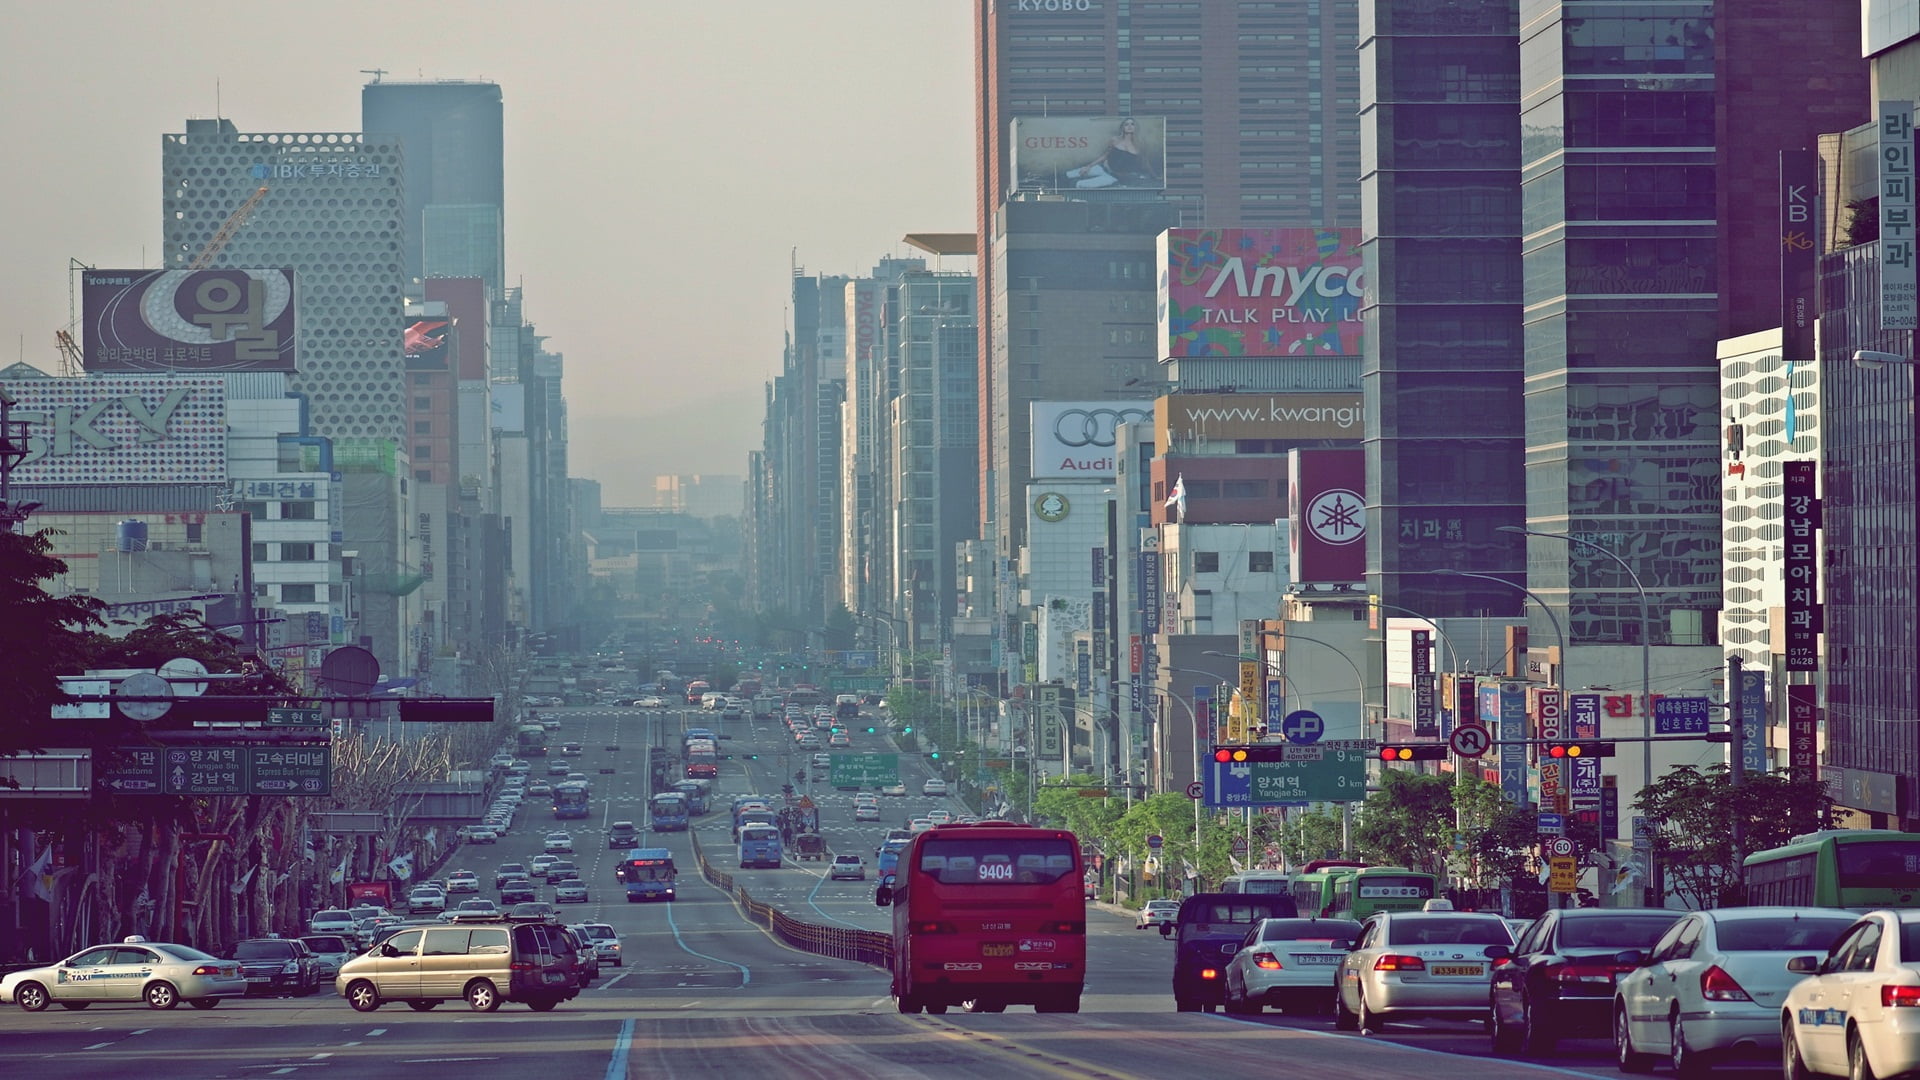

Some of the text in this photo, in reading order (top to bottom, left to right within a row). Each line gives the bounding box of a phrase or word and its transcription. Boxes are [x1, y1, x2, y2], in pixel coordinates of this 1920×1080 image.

[1018, 0, 1090, 11] KYOBO
[1025, 136, 1089, 149] GUESS
[273, 163, 380, 178] IBK 투자증권
[1885, 113, 1912, 268] 라인피부과
[1789, 186, 1807, 222] KB
[1202, 308, 1259, 323] TALK
[1272, 308, 1330, 323] PLAY
[857, 290, 875, 361] PAGODA
[97, 347, 214, 363] 헬리코박터 프로젝트
[1060, 457, 1113, 470] Audi
[1401, 518, 1441, 540] 치과
[1790, 495, 1813, 629] 강남모아치과
[1790, 648, 1812, 656] 517-
[1790, 657, 1814, 666] 0428
[1269, 683, 1280, 719] 세무사
[1656, 701, 1708, 714] 예측출발금지
[1326, 739, 1376, 749] 직진 후 좌회전
[171, 752, 186, 761] 92
[190, 750, 236, 762] 양재역
[255, 752, 324, 766] 고속터미널
[1336, 750, 1362, 762] 9 km
[192, 763, 225, 771] Yangjae
[257, 767, 320, 776] Express Bus Terminal
[1258, 761, 1290, 769] Naegok
[191, 772, 235, 785] 강남역
[306, 780, 318, 788] 31
[1258, 775, 1299, 788] 양재역
[1337, 776, 1346, 787] 3
[1576, 779, 1597, 788] (주)
[1258, 789, 1291, 797] Yangjae
[1556, 843, 1569, 852] 60
[979, 864, 1013, 880] 9404
[72, 974, 91, 982] TAXI
